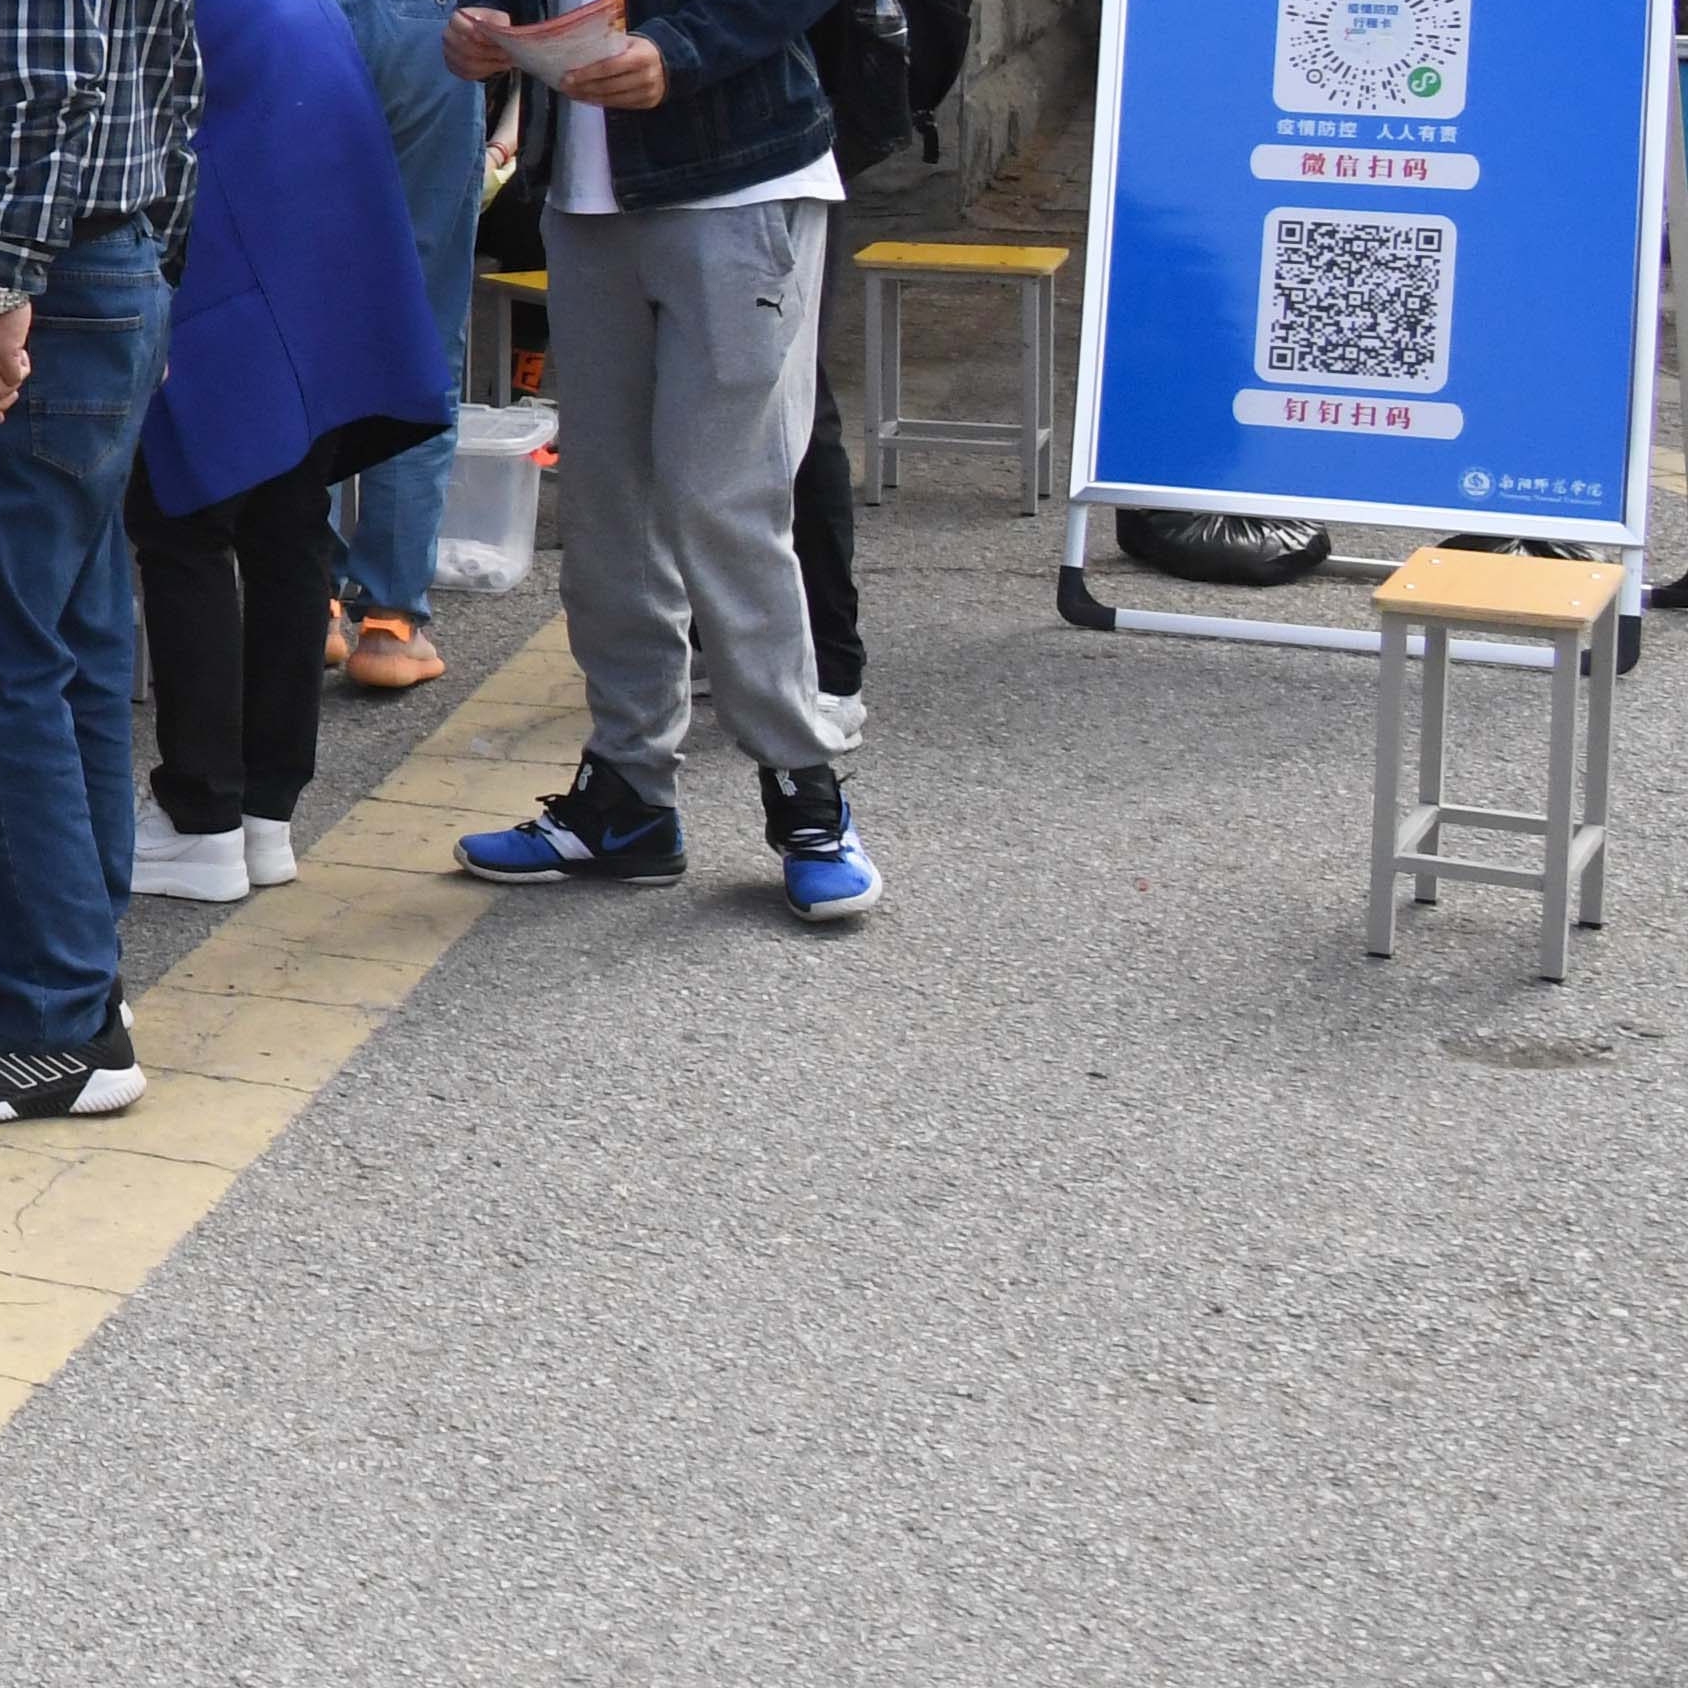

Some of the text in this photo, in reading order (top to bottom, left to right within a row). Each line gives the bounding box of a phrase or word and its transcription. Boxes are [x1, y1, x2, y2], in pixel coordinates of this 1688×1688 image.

[1277, 118, 1458, 143] 疫情防控 人人有责
[1301, 152, 1428, 181] 微信扫码
[1284, 397, 1412, 430] 钉钉扫码
